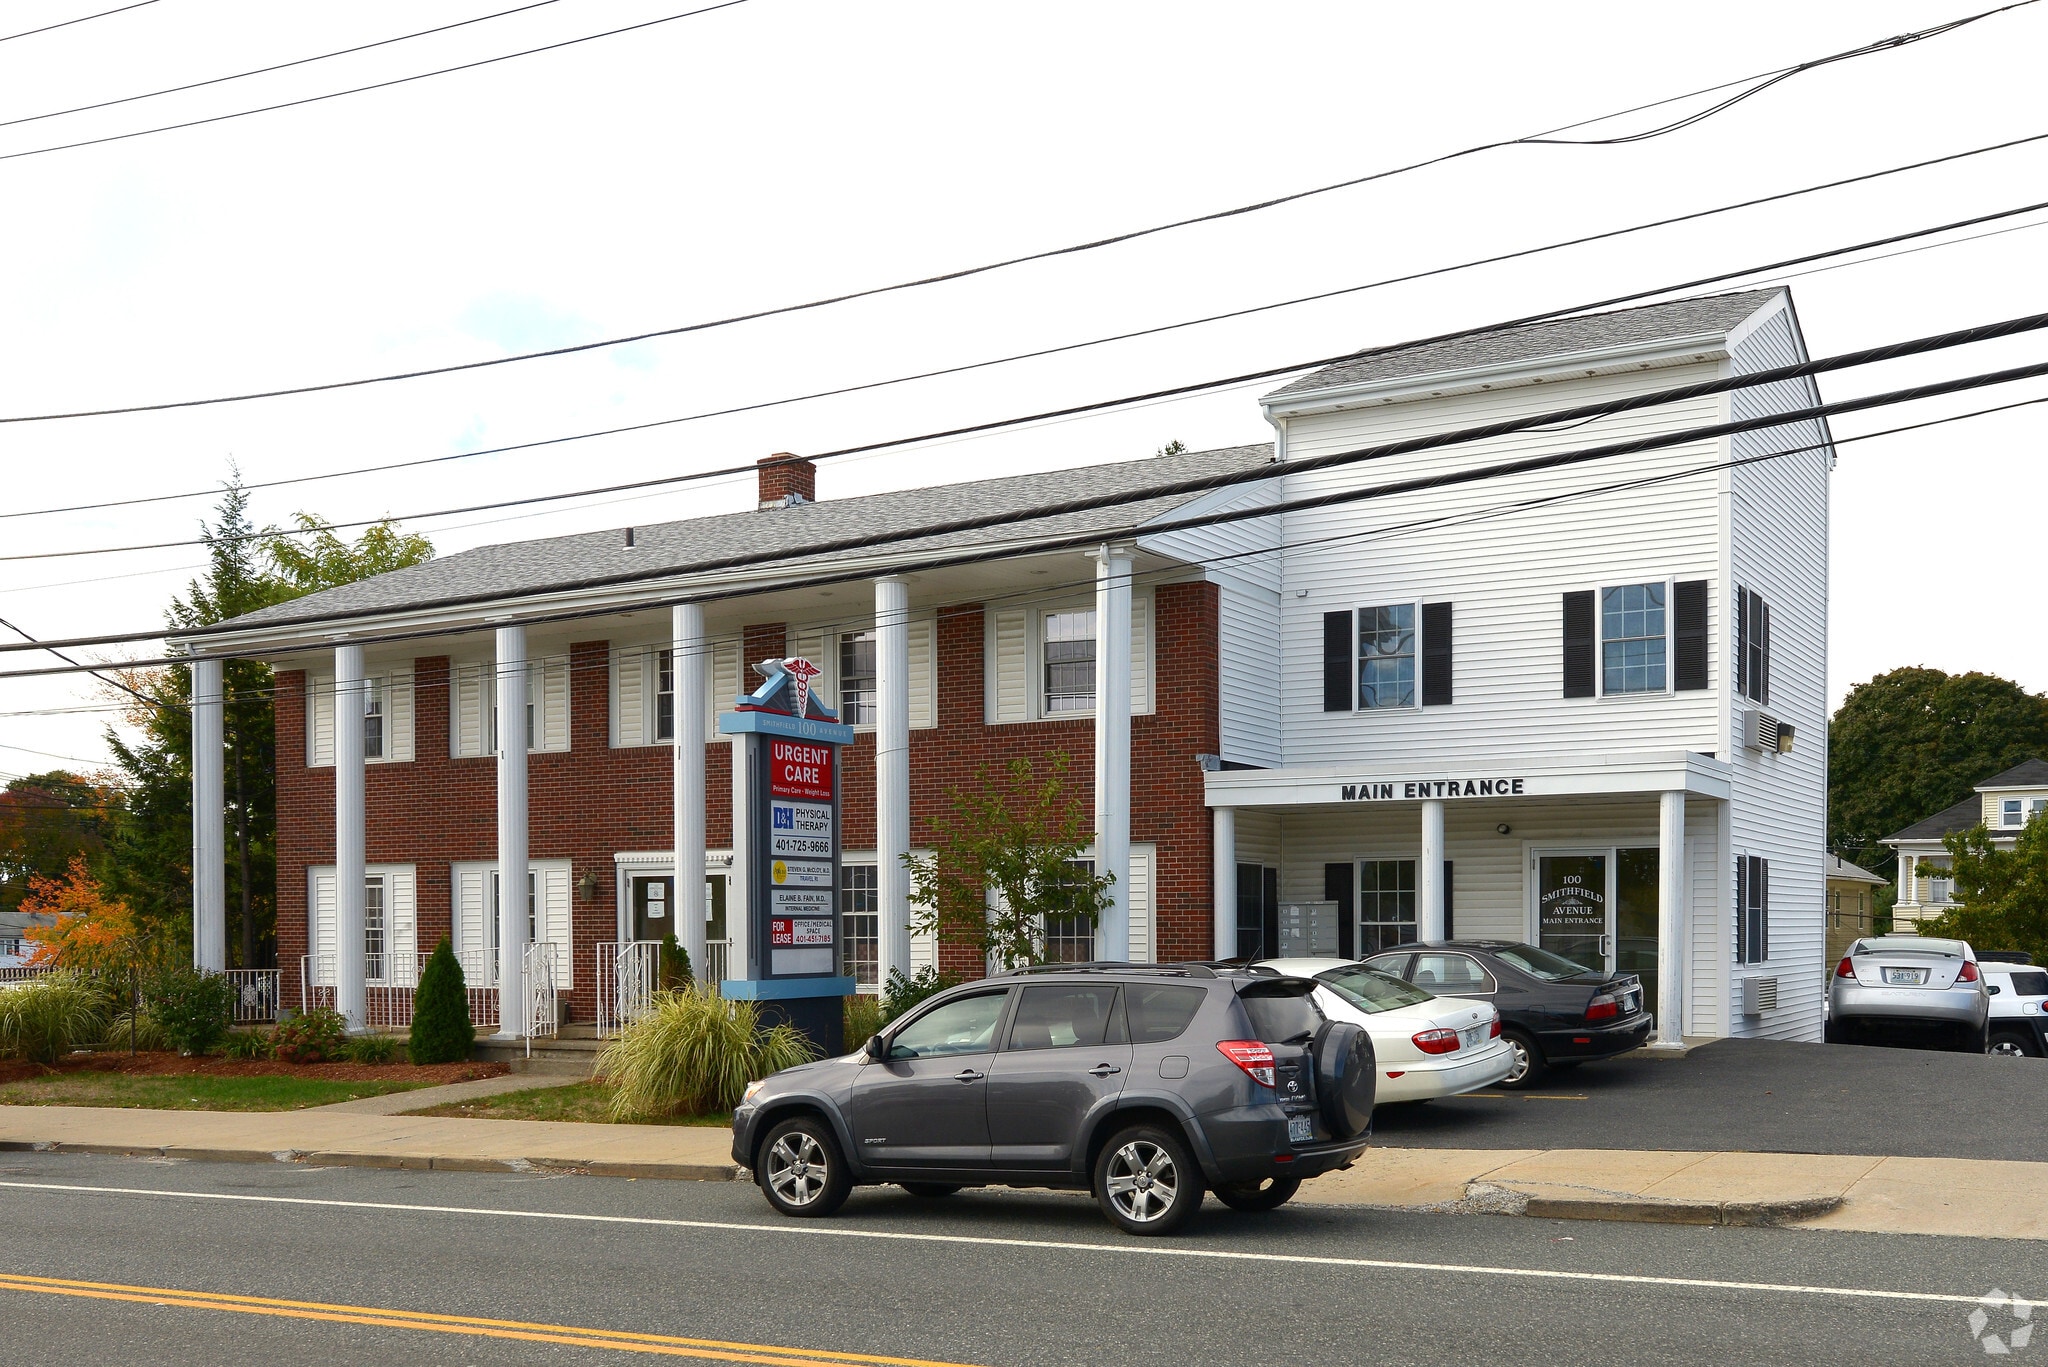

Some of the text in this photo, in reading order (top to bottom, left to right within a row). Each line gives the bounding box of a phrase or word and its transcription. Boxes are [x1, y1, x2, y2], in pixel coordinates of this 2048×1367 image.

[762, 719, 847, 737] SMITHFIELD 100 AVENUE
[774, 743, 829, 765] URGENT
[784, 764, 819, 784] CARE
[773, 785, 790, 795] Primary
[791, 786, 801, 794] Care
[804, 787, 820, 797] Weight
[820, 789, 830, 797] Loss
[1341, 778, 1524, 800] MAIN ENTRANCE
[795, 808, 830, 820] PHYSICAL
[796, 820, 829, 831] THERAPY
[775, 838, 829, 852] 401-725-9666
[1563, 875, 1582, 884] 100
[779, 894, 796, 902] ELAINE
[1541, 887, 1604, 904] SMITHFIELD
[1552, 906, 1593, 915] AVENUE
[772, 921, 785, 932] FOR
[772, 933, 792, 944] LEASE
